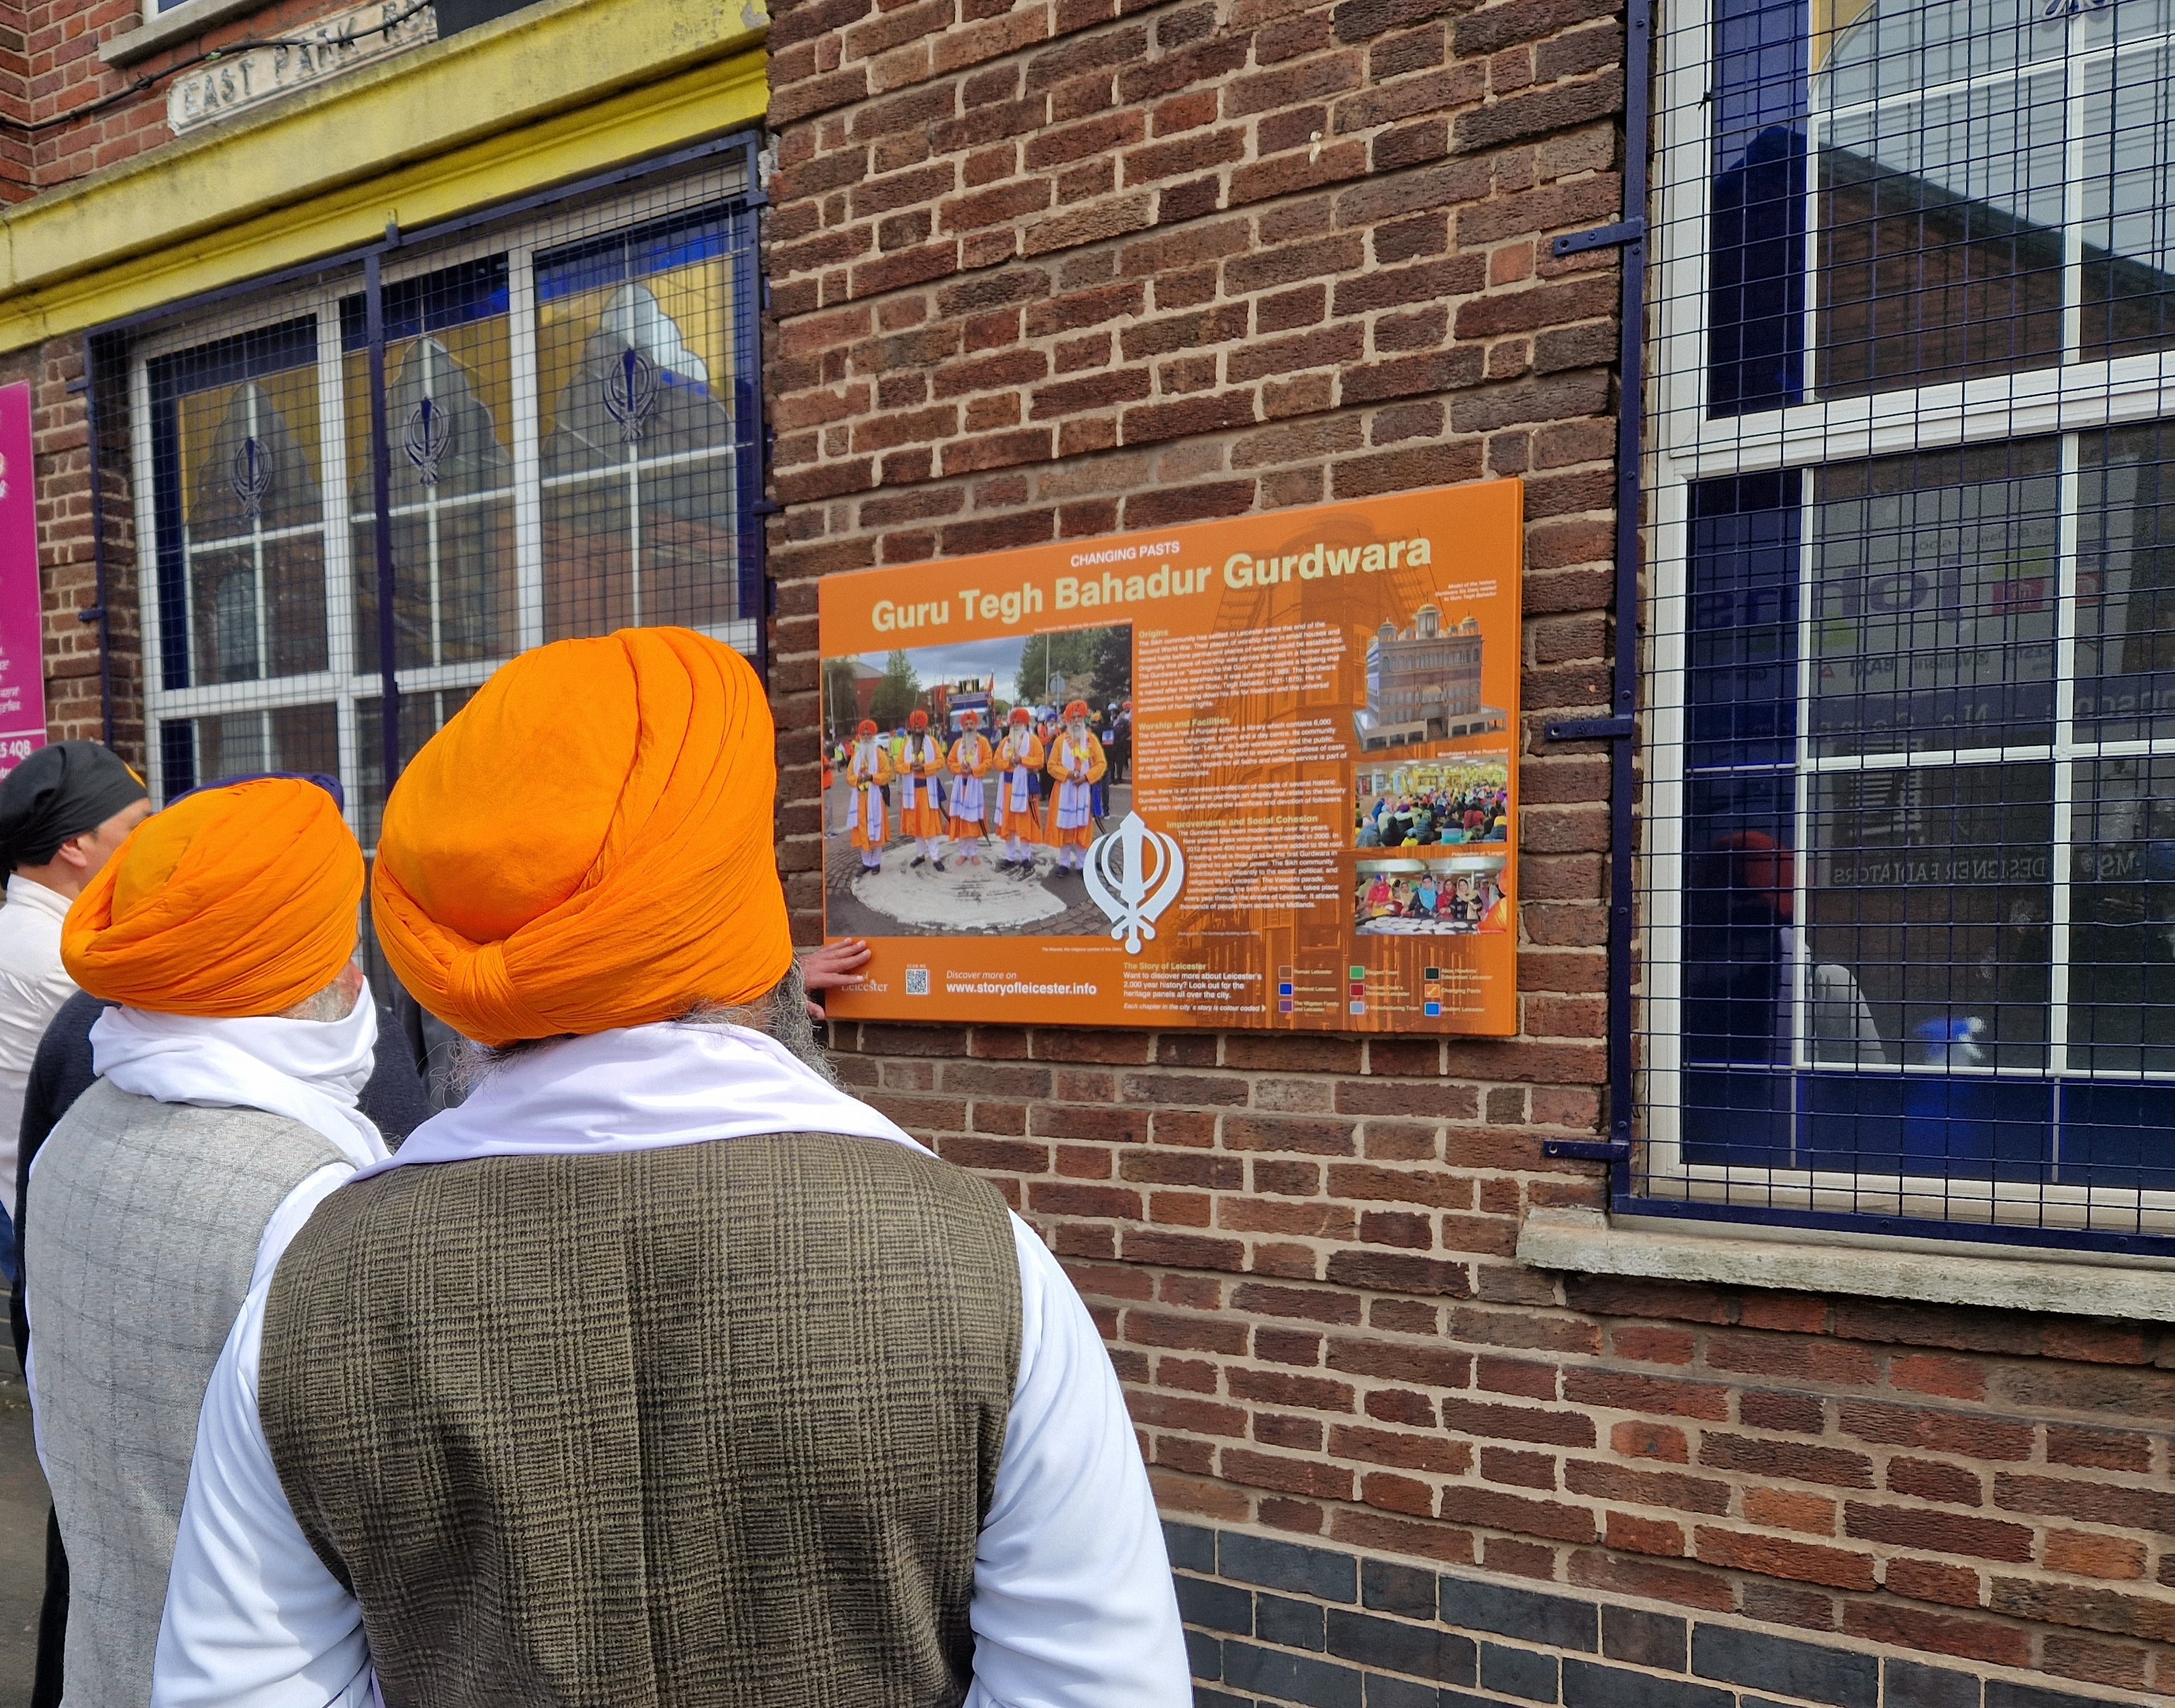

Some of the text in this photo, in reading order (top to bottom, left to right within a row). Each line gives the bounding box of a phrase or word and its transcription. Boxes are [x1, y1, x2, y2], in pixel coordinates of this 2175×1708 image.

[184, 58, 255, 117] EAST
[1070, 540, 1180, 568] CHANGING PASTS
[872, 538, 1432, 632] Guru Tegh Bahadur Gurdwara
[1138, 627, 1169, 640] Origins
[1138, 720, 1173, 732] Worship
[1192, 716, 1230, 725] Facilities
[9, 740, 31, 760] 4QB
[1167, 818, 1227, 829] Improvements
[1247, 815, 1274, 824] Social
[1276, 813, 1318, 822] Cohesion
[1139, 961, 1160, 971] Story
[1171, 961, 1206, 970] Leicester
[947, 970, 981, 979] Discover
[1006, 972, 1017, 980] on
[1201, 971, 1221, 979] about
[946, 981, 1097, 997] www.storyofleicester.info
[1143, 981, 1158, 990] year
[1160, 980, 1187, 990] history?
[1233, 981, 1244, 989] the
[1123, 989, 1151, 999] heritage
[1152, 989, 1176, 999] panels
[1203, 990, 1215, 998] the
